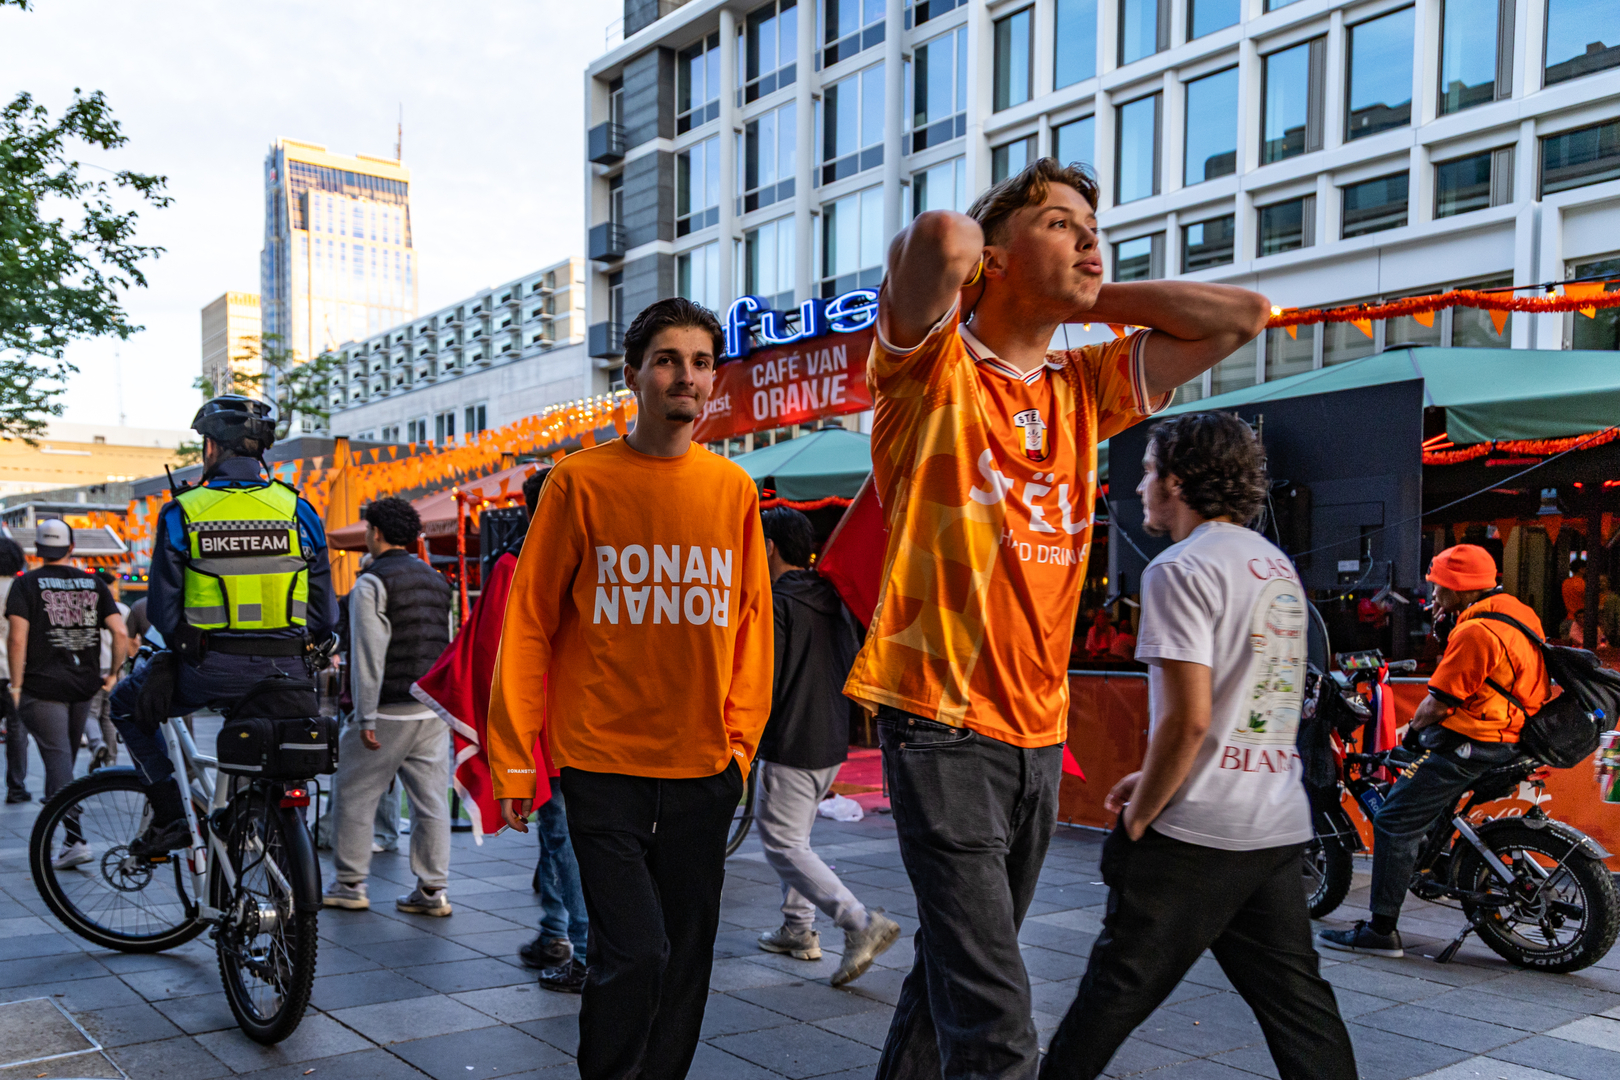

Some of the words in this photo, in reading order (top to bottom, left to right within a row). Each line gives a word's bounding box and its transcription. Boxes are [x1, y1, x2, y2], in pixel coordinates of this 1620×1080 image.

[752, 350, 800, 388] CAFÉ
[806, 344, 848, 376] VAN
[753, 373, 848, 421] ORANJE
[201, 535, 288, 552] BIKETEAM
[595, 544, 733, 587] RONAN
[1247, 556, 1297, 580] CAS
[593, 585, 730, 627] RONAN
[1522, 945, 1584, 966] KENDA
